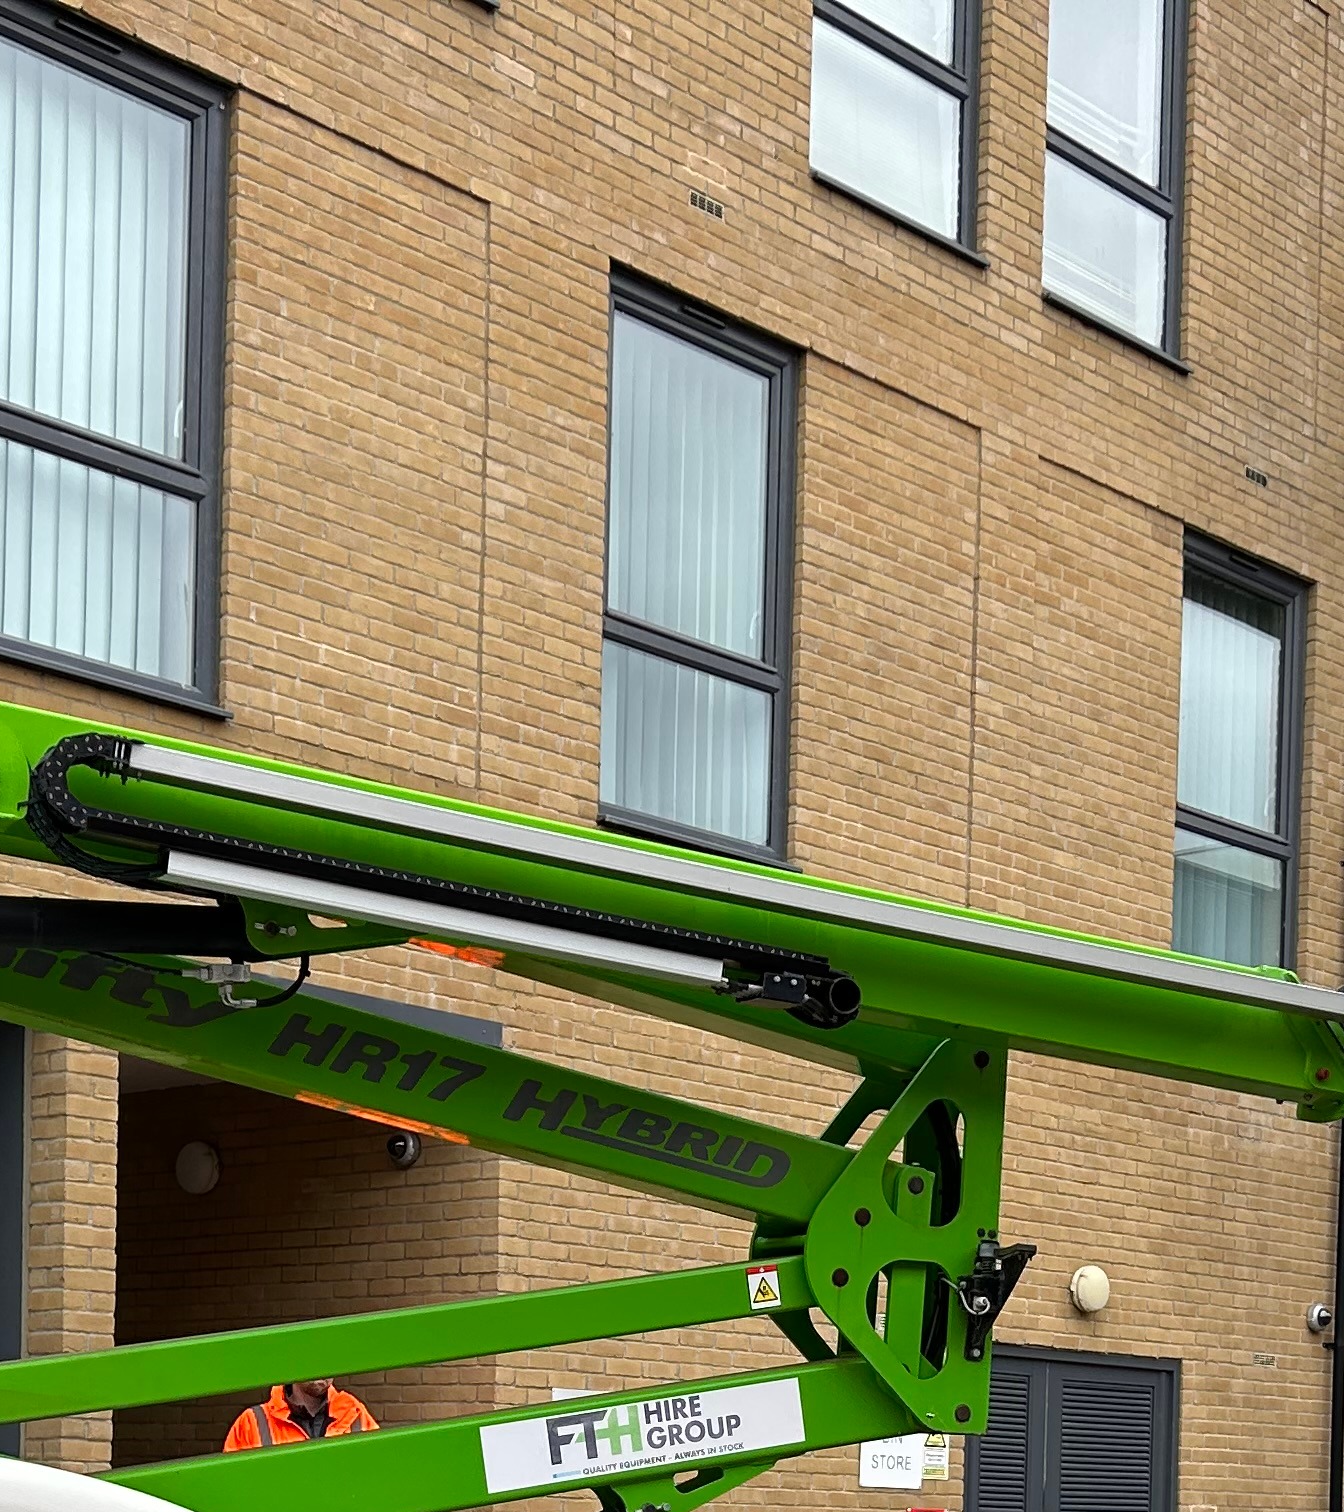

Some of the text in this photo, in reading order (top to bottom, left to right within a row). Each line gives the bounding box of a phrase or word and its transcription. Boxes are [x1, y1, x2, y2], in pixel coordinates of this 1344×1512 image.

[268, 1013, 792, 1189] HR17 HYBRID
[545, 1395, 702, 1466] FTH HIRE
[645, 1413, 742, 1450] GROUP
[582, 1461, 618, 1475] QUALITY
[618, 1454, 667, 1470] EQUIPMENT
[674, 1447, 706, 1461] ALWAYS
[706, 1446, 718, 1456] IN
[718, 1441, 745, 1453] STOCK
[871, 1454, 912, 1471] STORE
